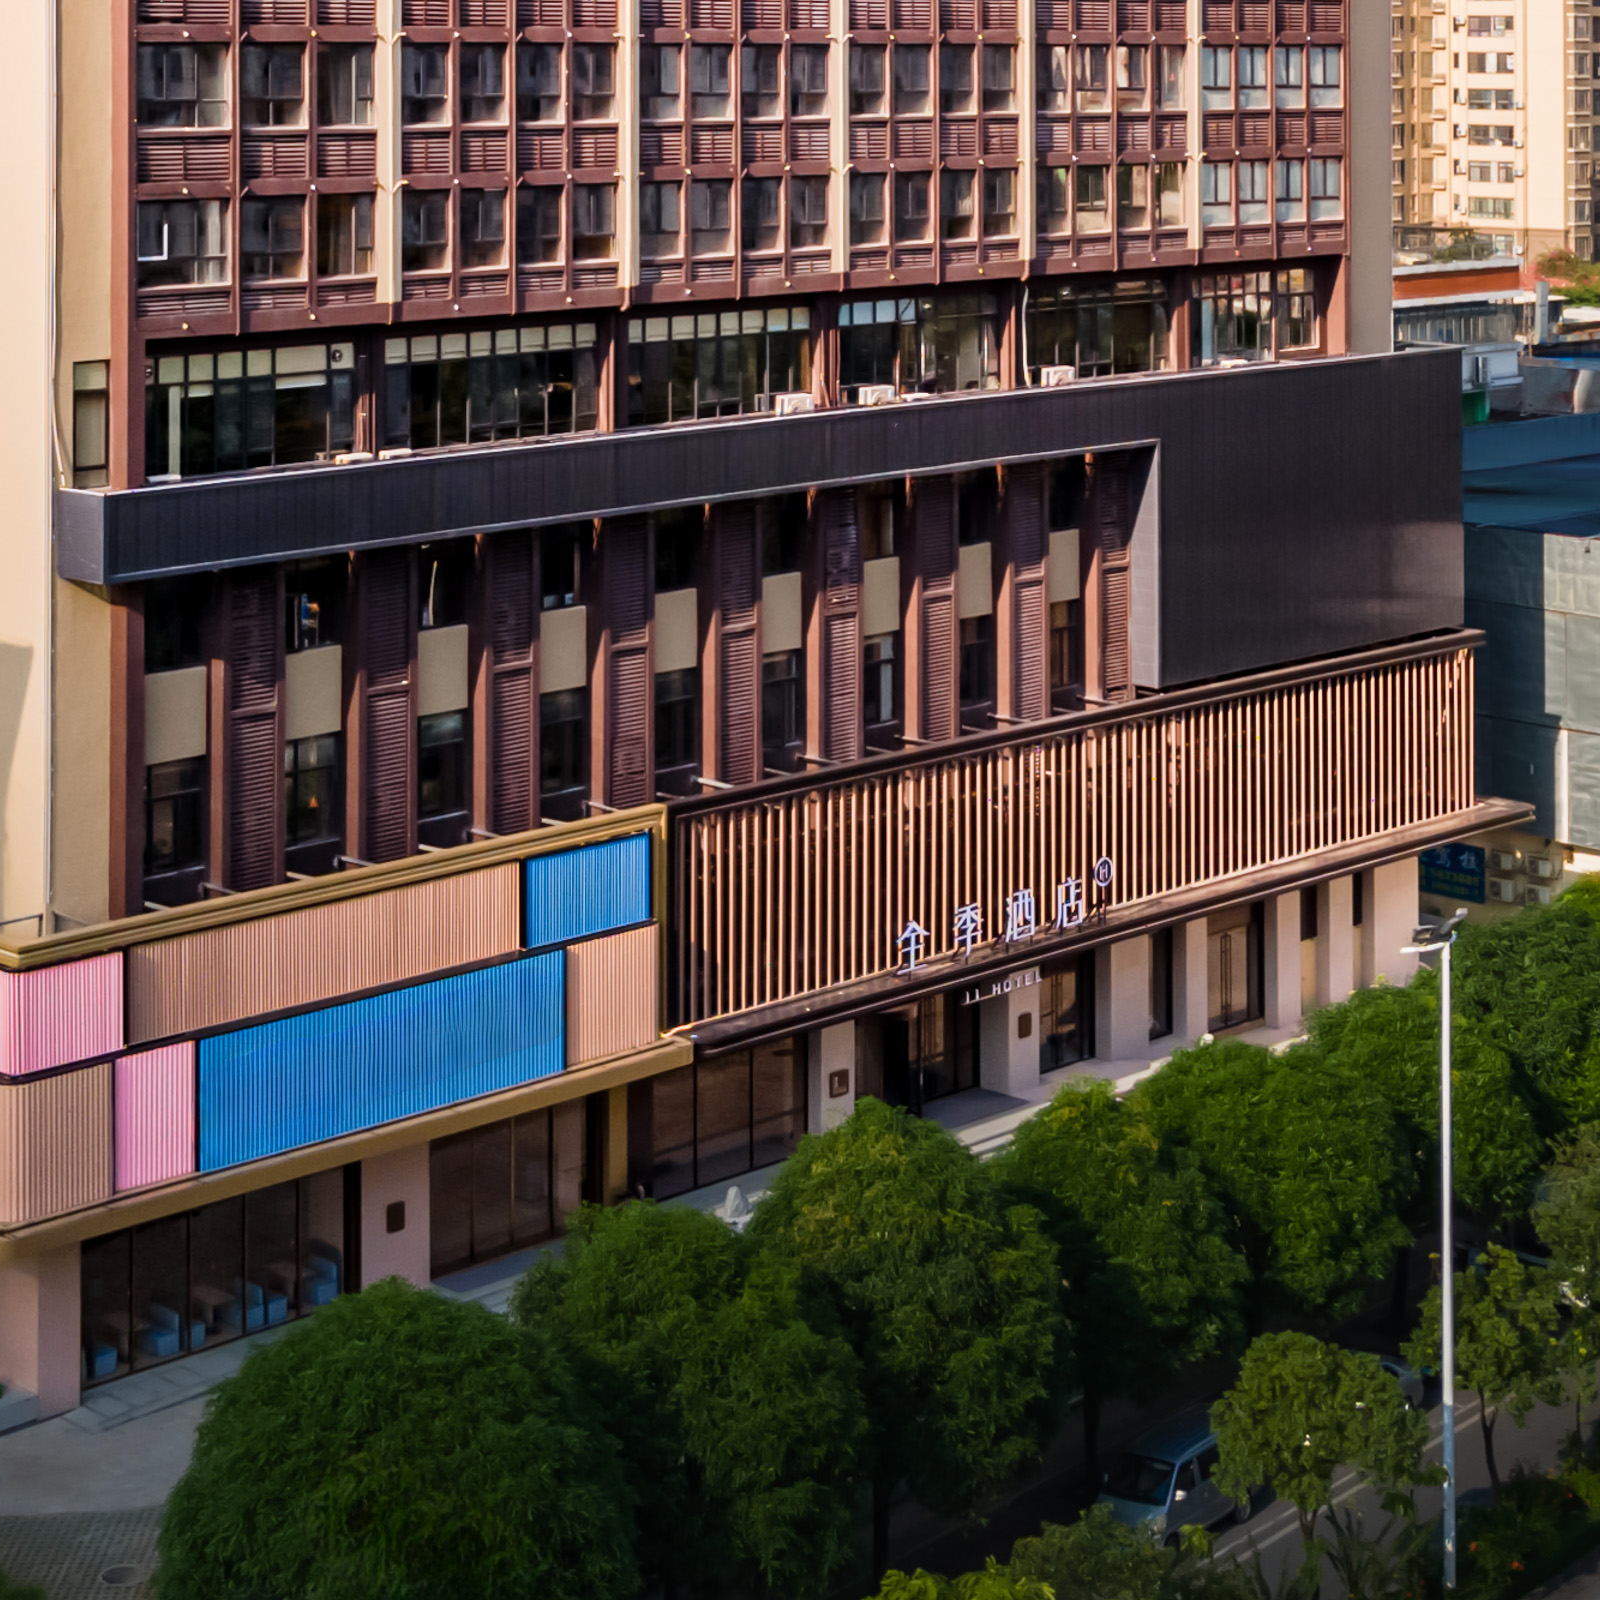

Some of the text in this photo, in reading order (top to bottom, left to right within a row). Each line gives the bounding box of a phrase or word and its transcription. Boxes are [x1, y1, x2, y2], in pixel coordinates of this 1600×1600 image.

[896, 876, 1084, 976] 全季酒店
[991, 968, 1043, 996] HOTEL
